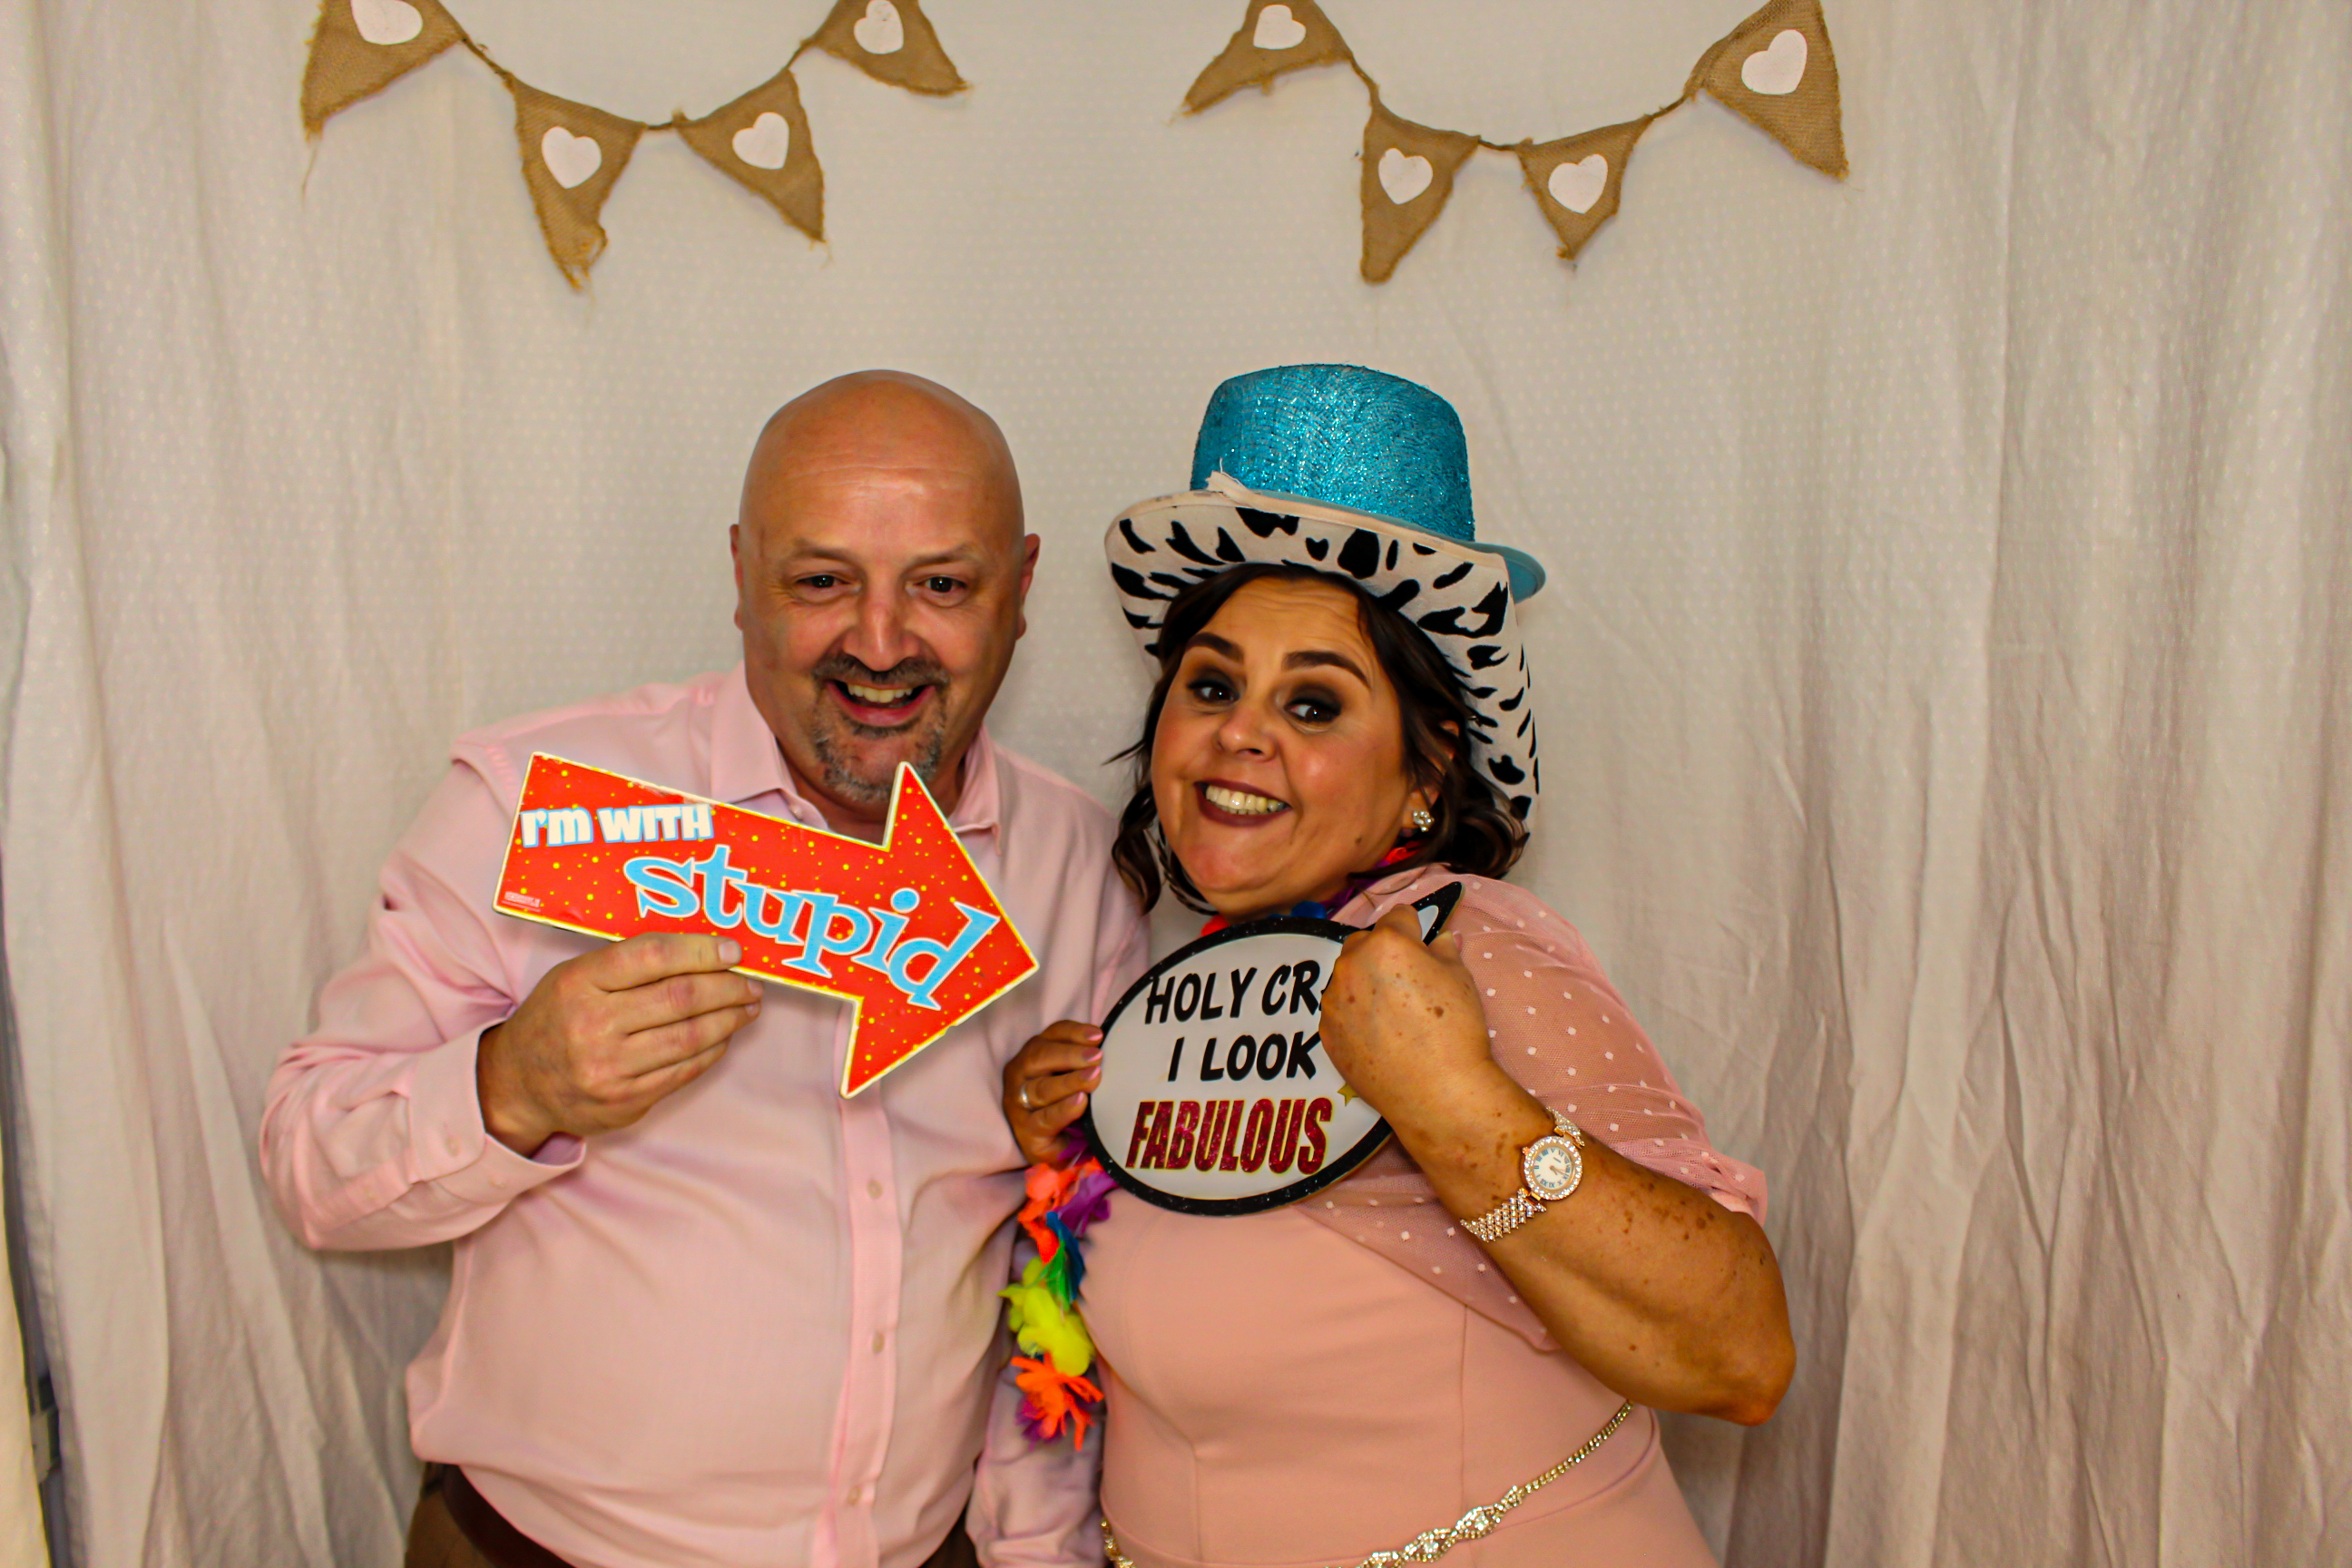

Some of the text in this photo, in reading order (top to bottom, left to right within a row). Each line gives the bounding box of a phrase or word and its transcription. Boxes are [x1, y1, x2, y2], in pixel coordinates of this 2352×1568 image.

[521, 803, 714, 848] I'm WITH
[623, 845, 1000, 1011] stupid
[1144, 959, 1334, 1024] HOLY CR
[1167, 1031, 1322, 1082] I LOOK
[1125, 1097, 1333, 1175] FABULOUS
